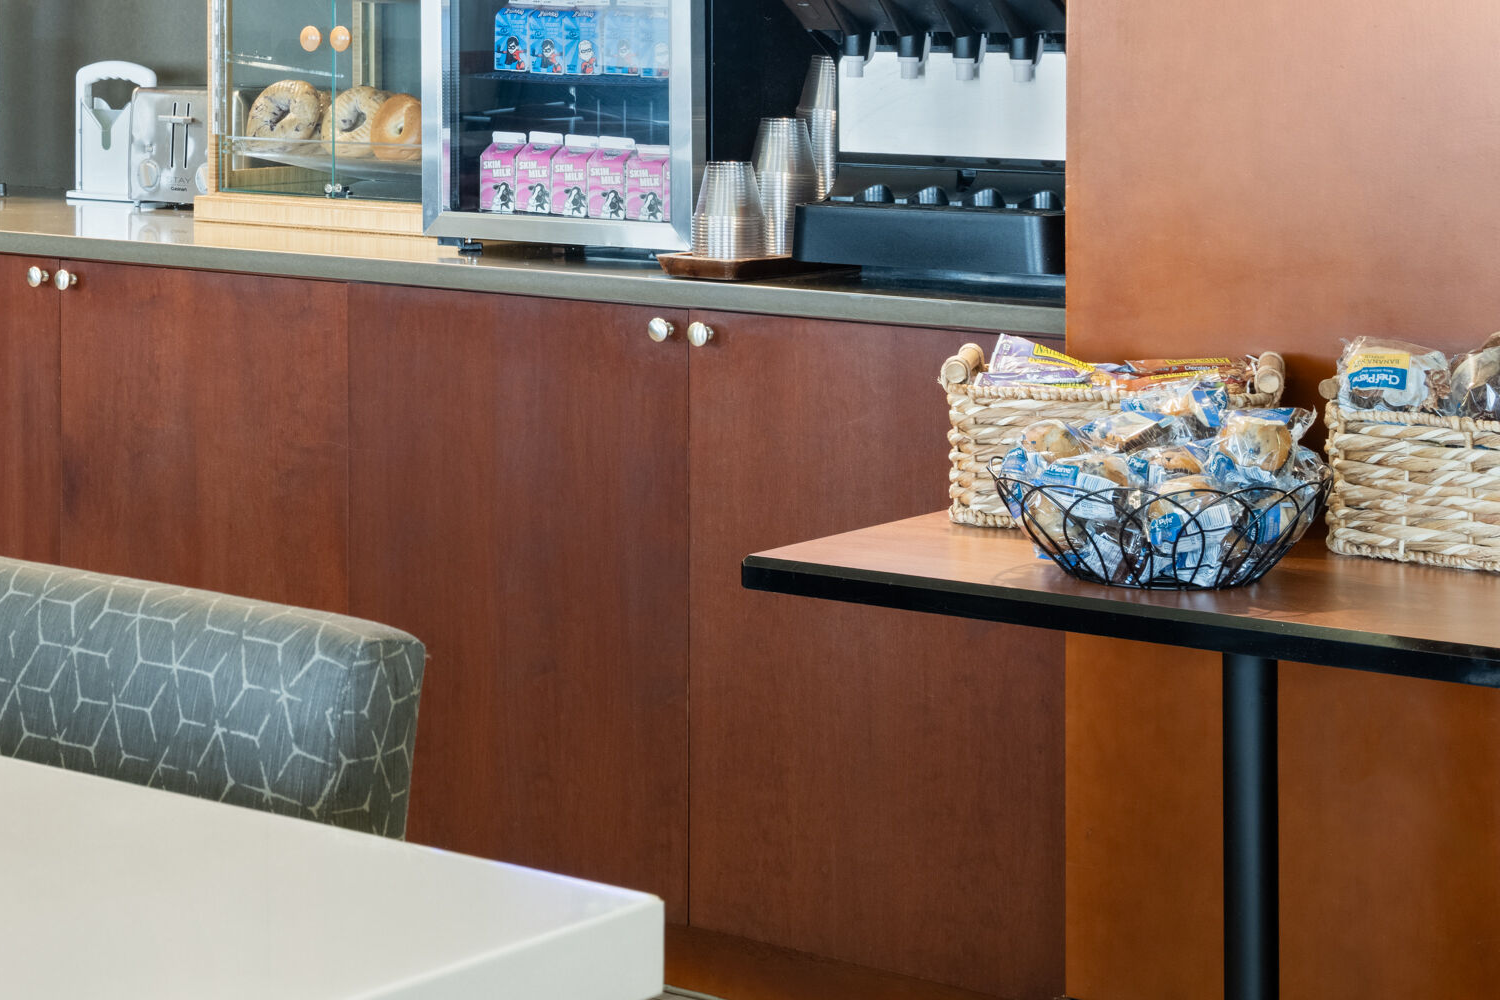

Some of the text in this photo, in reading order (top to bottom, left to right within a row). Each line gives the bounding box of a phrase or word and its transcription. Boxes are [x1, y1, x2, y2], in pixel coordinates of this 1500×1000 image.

[483, 160, 501, 169] SKIM
[519, 160, 537, 170] SKIM
[554, 163, 573, 173] SKIM
[492, 168, 511, 177] MILK
[528, 169, 548, 178] MILK
[590, 167, 610, 176] SKIM
[629, 169, 649, 178] SKIM
[564, 172, 584, 182] MILK
[600, 175, 621, 185] MILK
[639, 177, 660, 187] MILK
